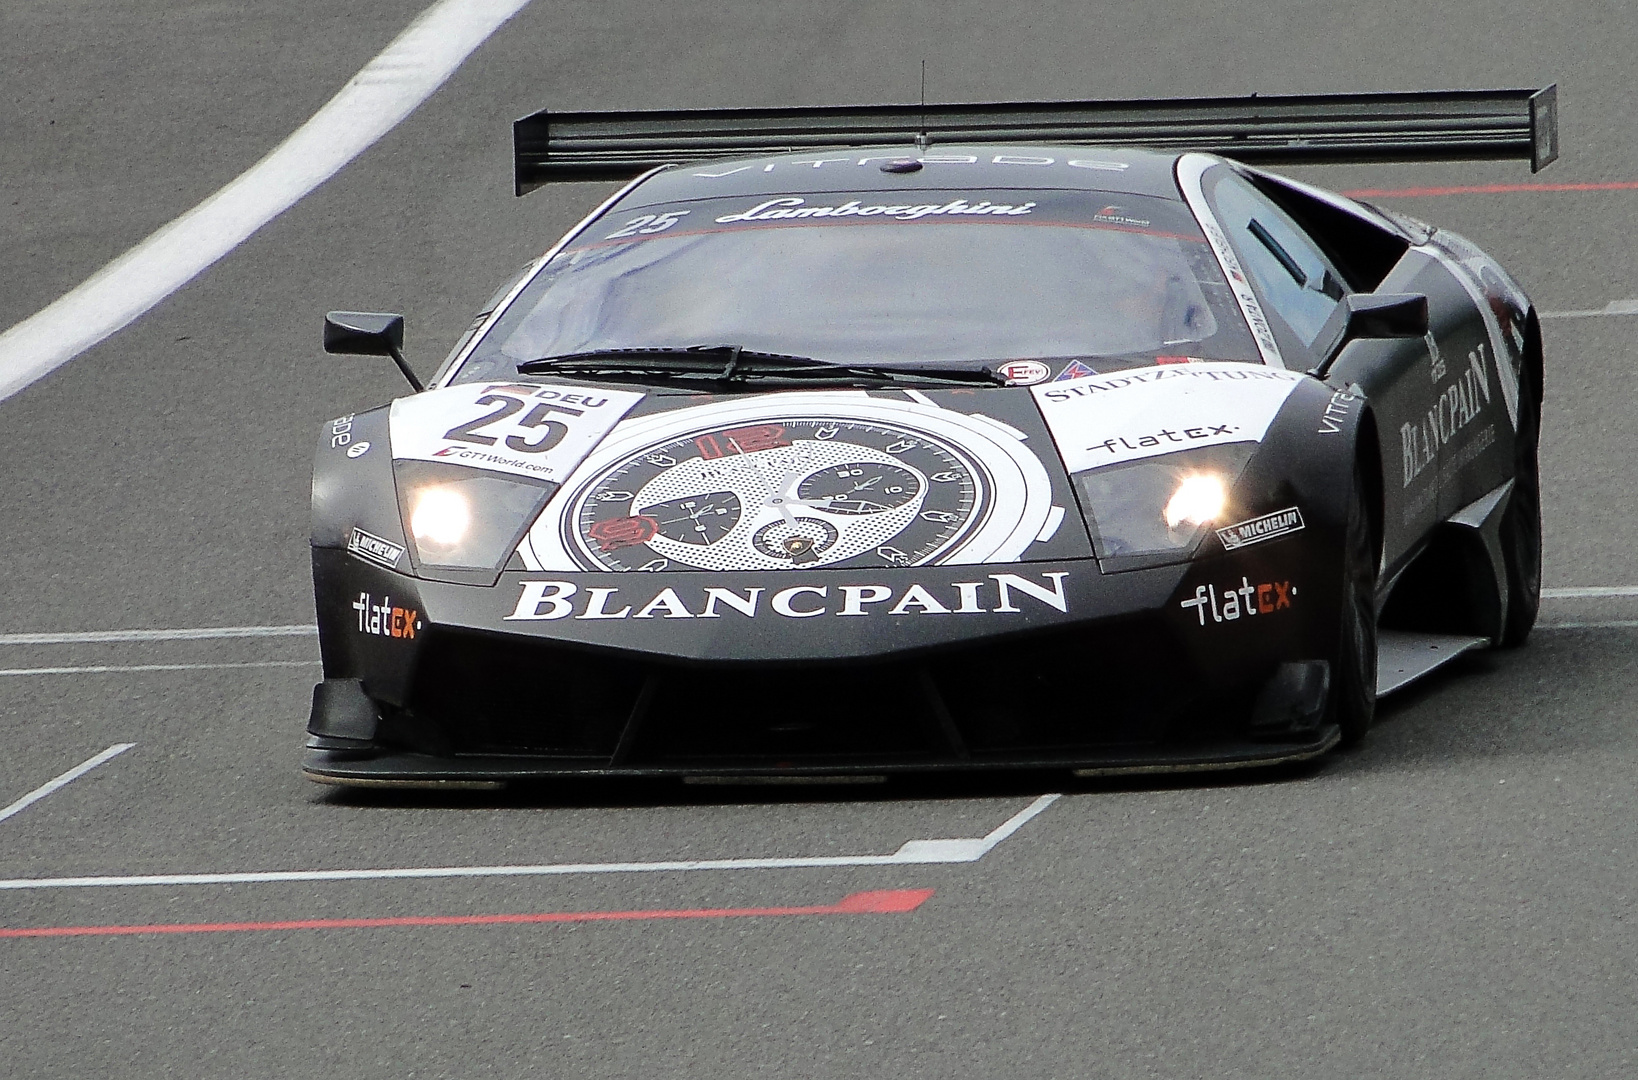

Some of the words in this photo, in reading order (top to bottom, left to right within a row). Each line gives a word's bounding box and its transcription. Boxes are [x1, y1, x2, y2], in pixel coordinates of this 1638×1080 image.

[714, 197, 1039, 225] Lamborghini
[604, 210, 692, 242] 25
[532, 388, 609, 409] DEU
[442, 393, 586, 457] 25
[1399, 342, 1492, 490] BLANCPAIN
[459, 448, 555, 476] GT1World.com
[1238, 511, 1298, 540] MICHELIN
[359, 535, 402, 561] MICHELIN
[503, 571, 1070, 622] BLANCPAIN
